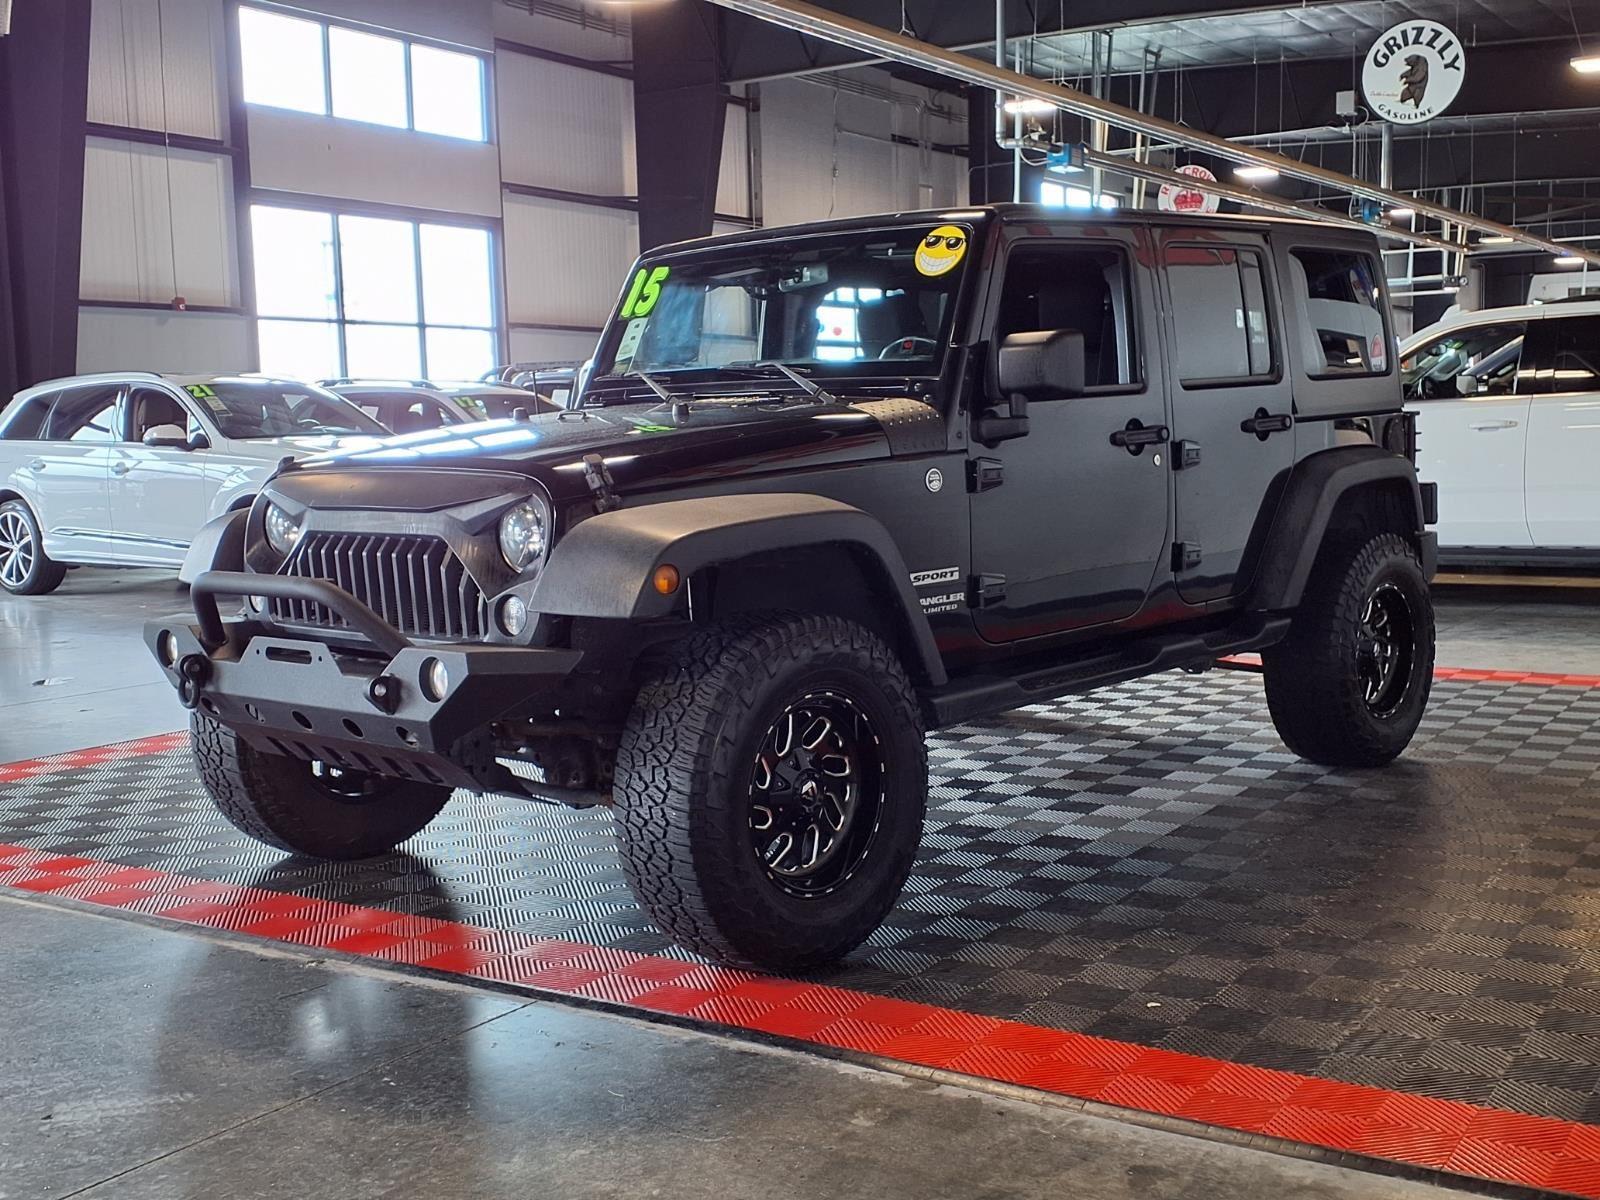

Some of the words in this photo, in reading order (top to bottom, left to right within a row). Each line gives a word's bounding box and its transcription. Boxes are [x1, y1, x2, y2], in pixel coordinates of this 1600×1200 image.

[1373, 26, 1461, 71] GRIZZLY
[1378, 104, 1434, 120] GASOLINE
[620, 266, 670, 318] 15
[186, 385, 216, 398] 21
[912, 570, 957, 582] SPORT
[920, 592, 965, 605] ANGLER
[923, 604, 958, 614] LIMITED
